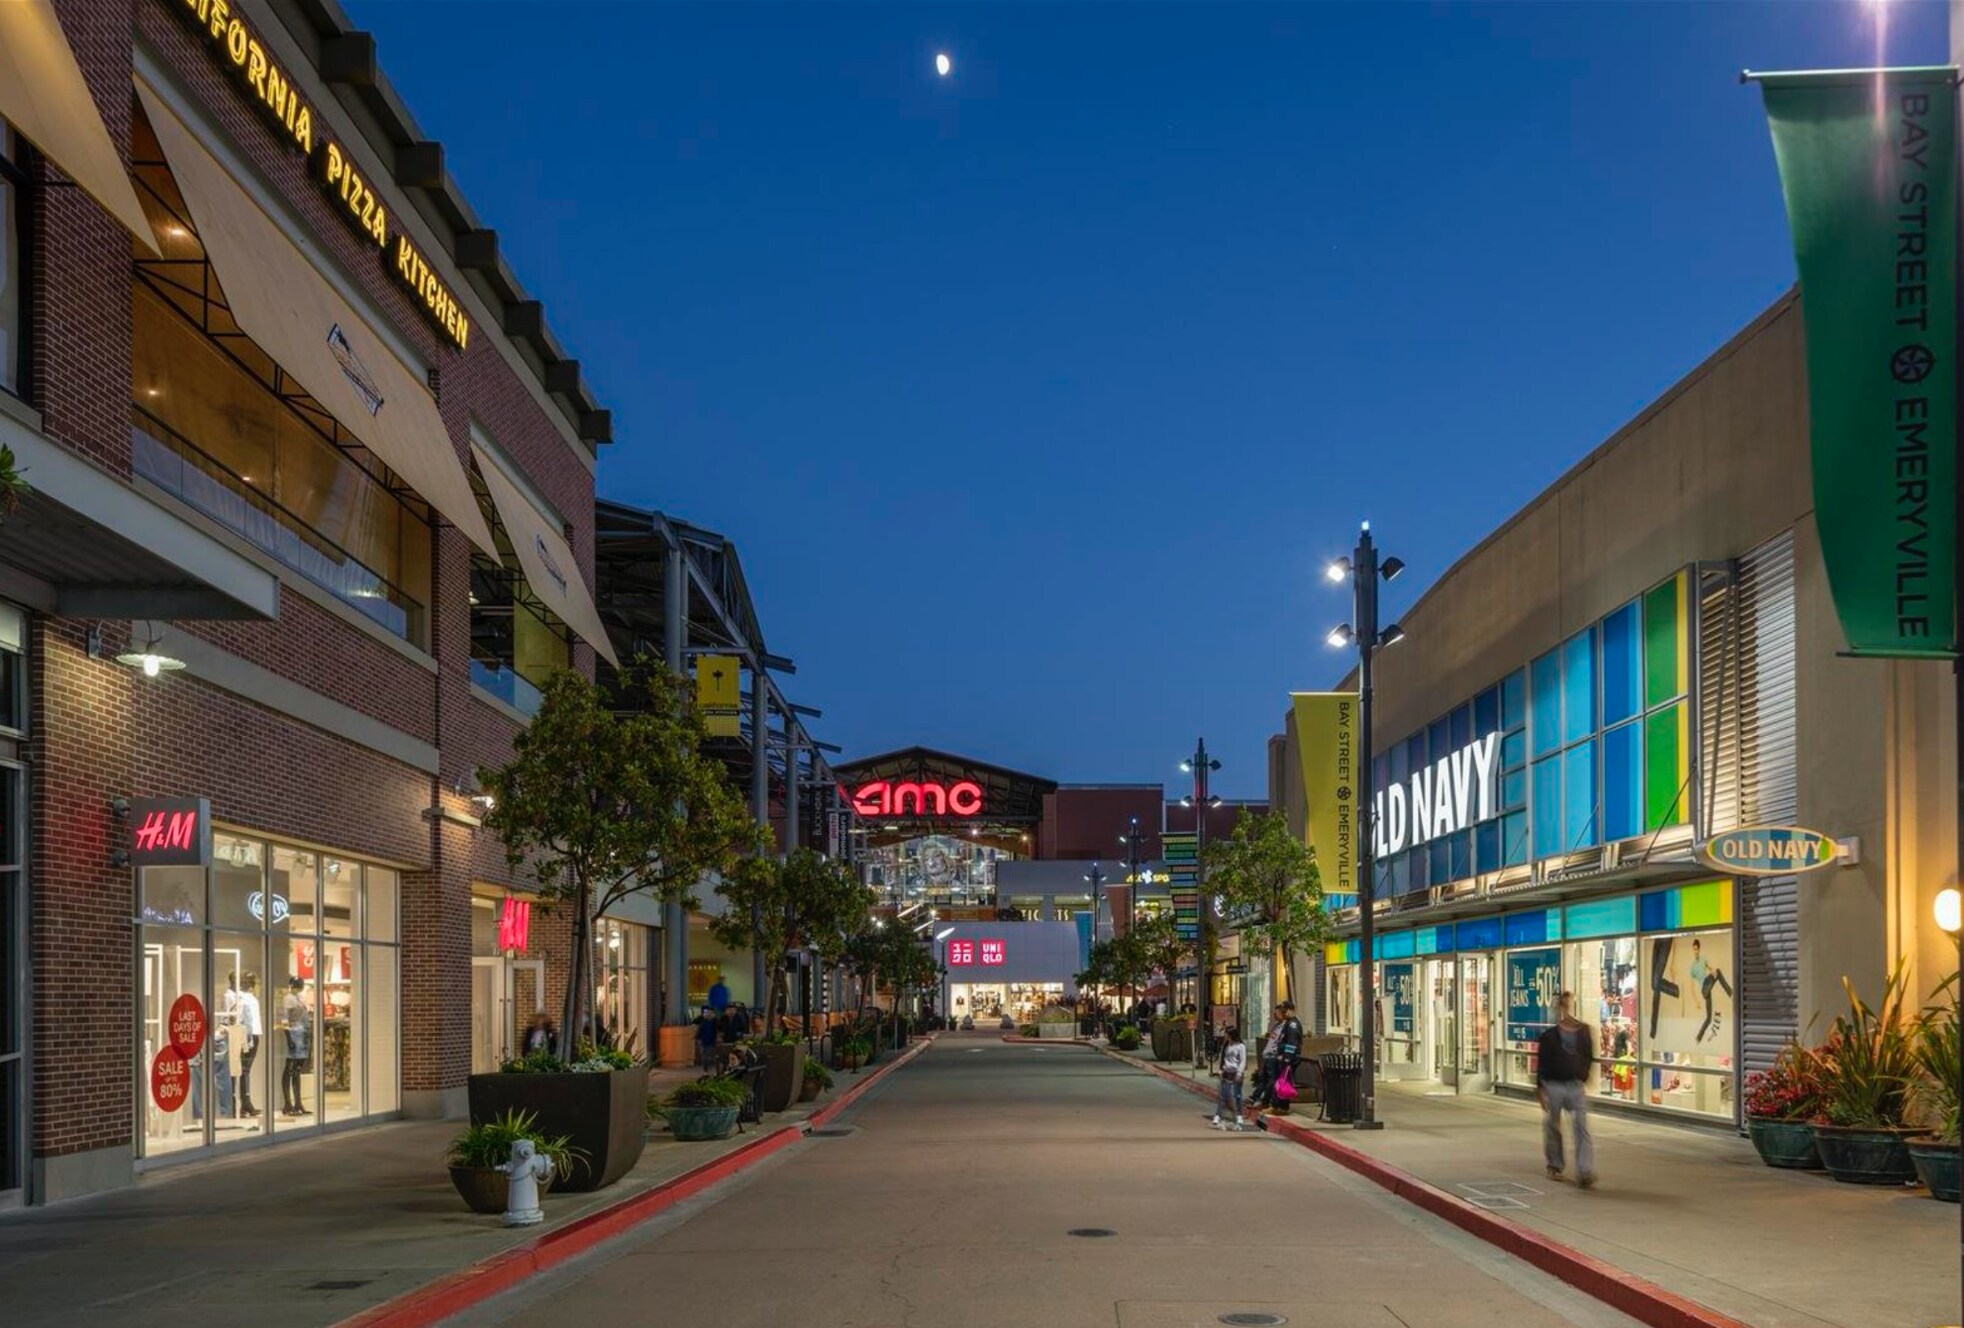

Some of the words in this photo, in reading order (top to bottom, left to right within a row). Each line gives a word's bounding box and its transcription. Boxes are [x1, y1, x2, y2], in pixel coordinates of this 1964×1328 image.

[1900, 93, 1930, 170] BAY
[327, 143, 386, 248] PIZZA
[399, 236, 469, 350] KITCHEN
[1896, 183, 1929, 332] STREET
[1895, 397, 1929, 639] EMERYVILLE
[1338, 702, 1350, 728] BAY
[1338, 731, 1350, 783] STREET
[1412, 731, 1501, 846] NAVY
[136, 812, 196, 850] H&M
[1338, 804, 1350, 887] EMERYVILLE
[1722, 840, 1763, 859] OLD
[1767, 839, 1821, 860] NAVY
[173, 1022, 192, 1032] DAYS
[192, 1022, 201, 1032] OF
[179, 1011, 197, 1021] LAST
[179, 1032, 197, 1043] SALE
[158, 1061, 184, 1075] SALE
[160, 1083, 183, 1098] 80%
